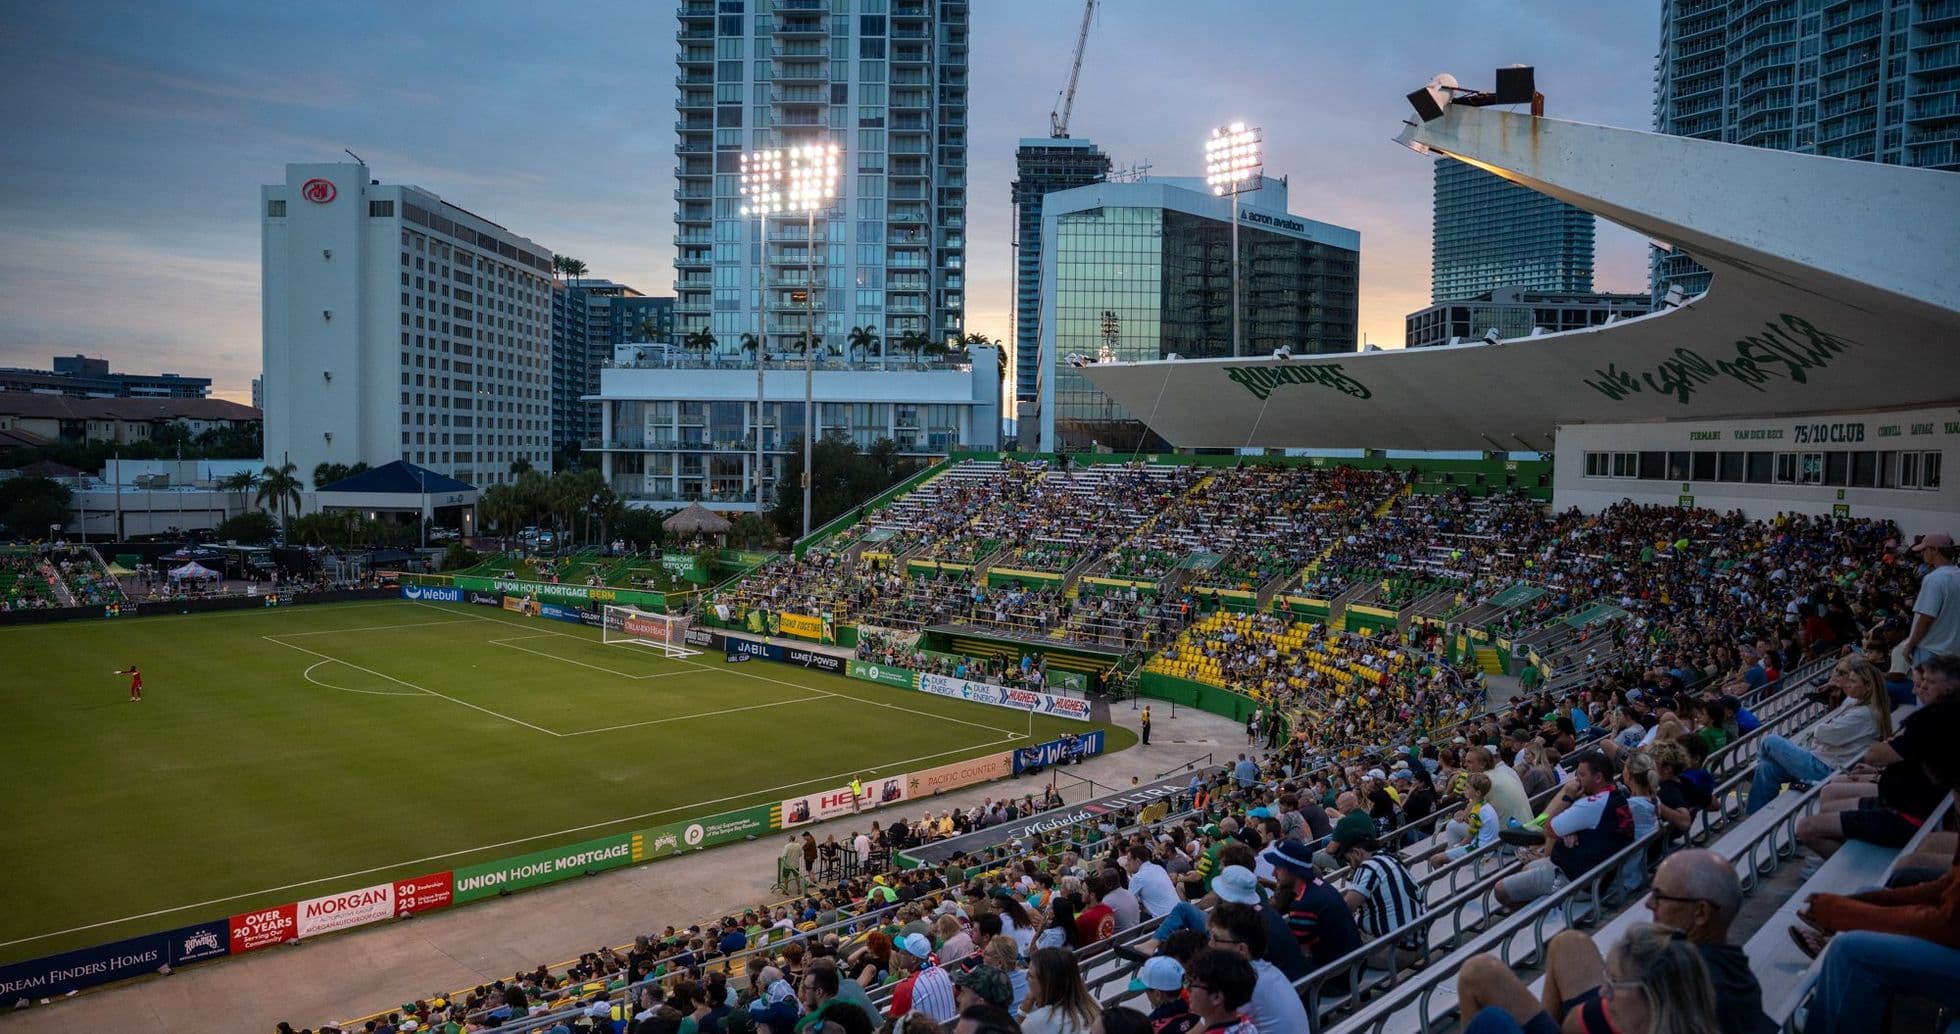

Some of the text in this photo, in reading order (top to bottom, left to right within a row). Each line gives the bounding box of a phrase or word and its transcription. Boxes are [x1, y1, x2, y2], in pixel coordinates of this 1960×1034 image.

[1248, 212, 1304, 232] acron aviation
[1794, 423, 1865, 443] 75/10 CLUB
[423, 589, 457, 601] Webull
[544, 585, 588, 598] MORTGAGE
[589, 589, 616, 600] BERM
[738, 642, 769, 657] JABIL
[813, 657, 838, 668] POWER
[931, 676, 948, 687] DUKE
[931, 684, 954, 696] ENERGY
[973, 685, 990, 694] DUKE
[1008, 690, 1036, 703] HUGHES
[973, 693, 998, 704] ENERGY
[1055, 698, 1084, 711] HUGHES
[928, 763, 996, 786] PACIFIC COUNTER
[1008, 785, 1185, 839] Michelob ULTRA
[457, 843, 629, 891] UNION HOME MORTGAGE
[399, 884, 416, 897] 30
[306, 888, 387, 918] MORGAN
[399, 897, 416, 911] 23
[246, 910, 280, 926] OVER
[233, 917, 292, 939] 20 YEARS
[50, 960, 107, 984] FINDERS
[110, 950, 158, 971] HOMES
